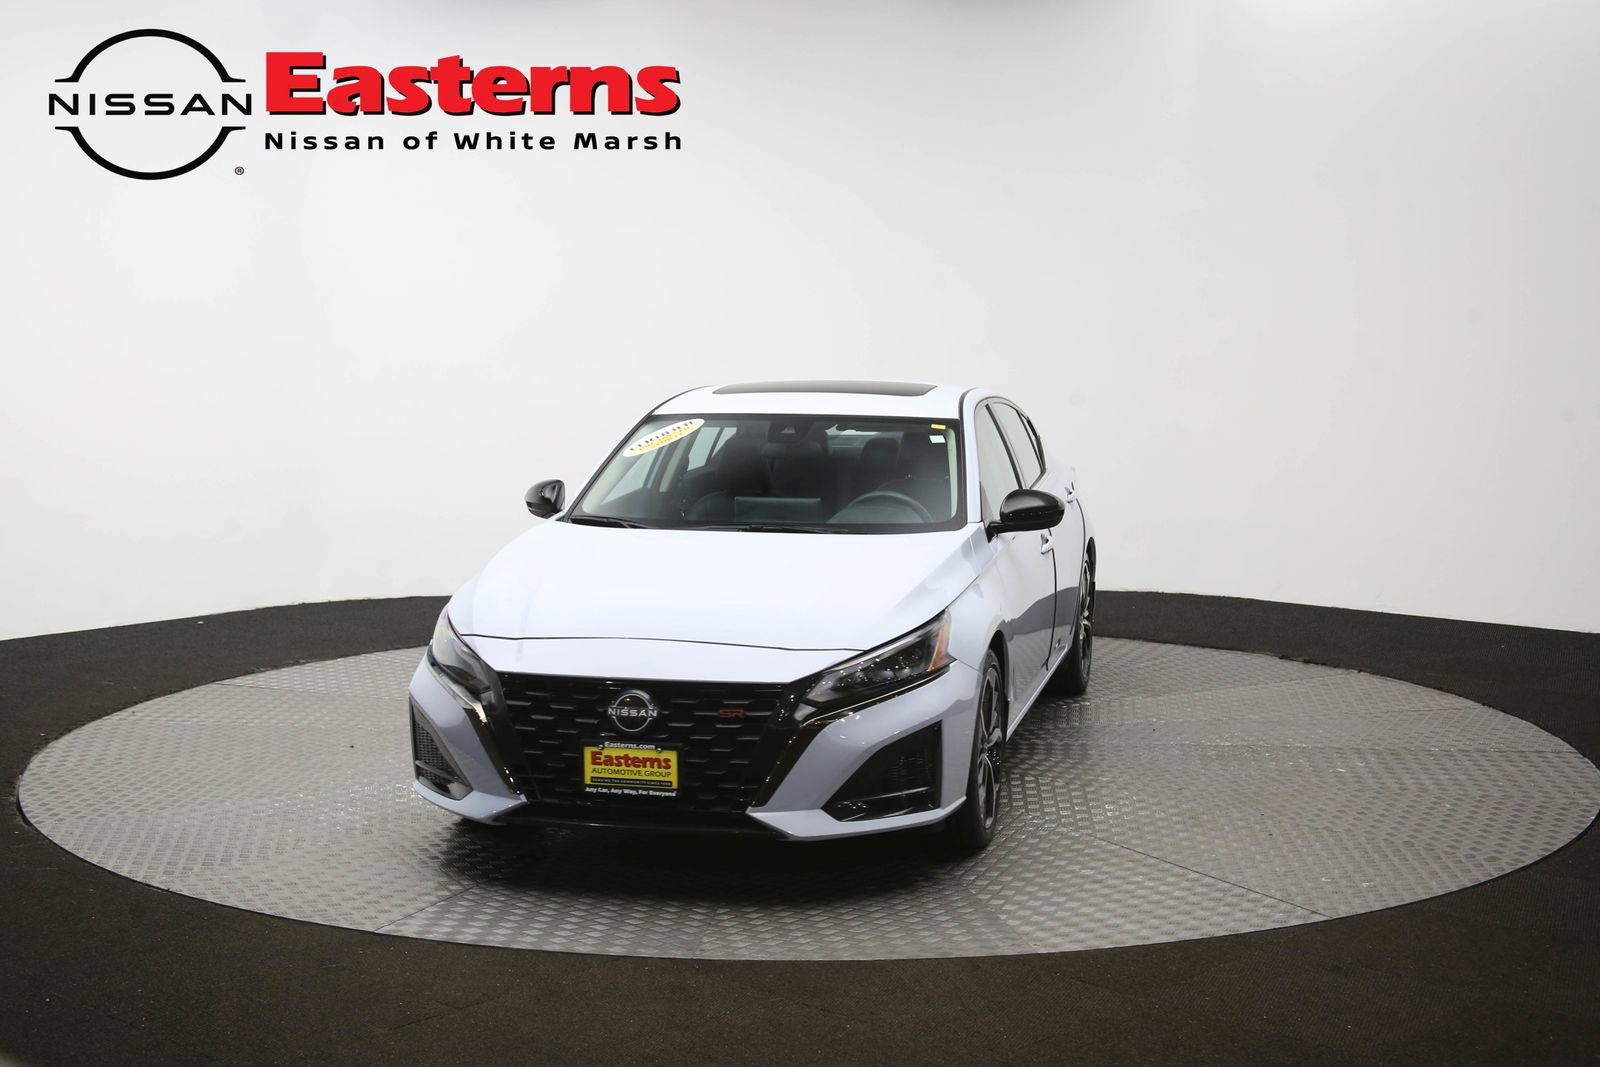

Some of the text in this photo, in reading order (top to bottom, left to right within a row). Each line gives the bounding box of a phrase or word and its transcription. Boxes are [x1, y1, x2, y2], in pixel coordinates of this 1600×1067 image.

[608, 706, 657, 717] NISSAN
[719, 709, 745, 718] SR
[604, 742, 655, 750] Easterns.com
[591, 751, 671, 769] Easterns
[592, 767, 671, 777] AUTOMOTIVE GROUP
